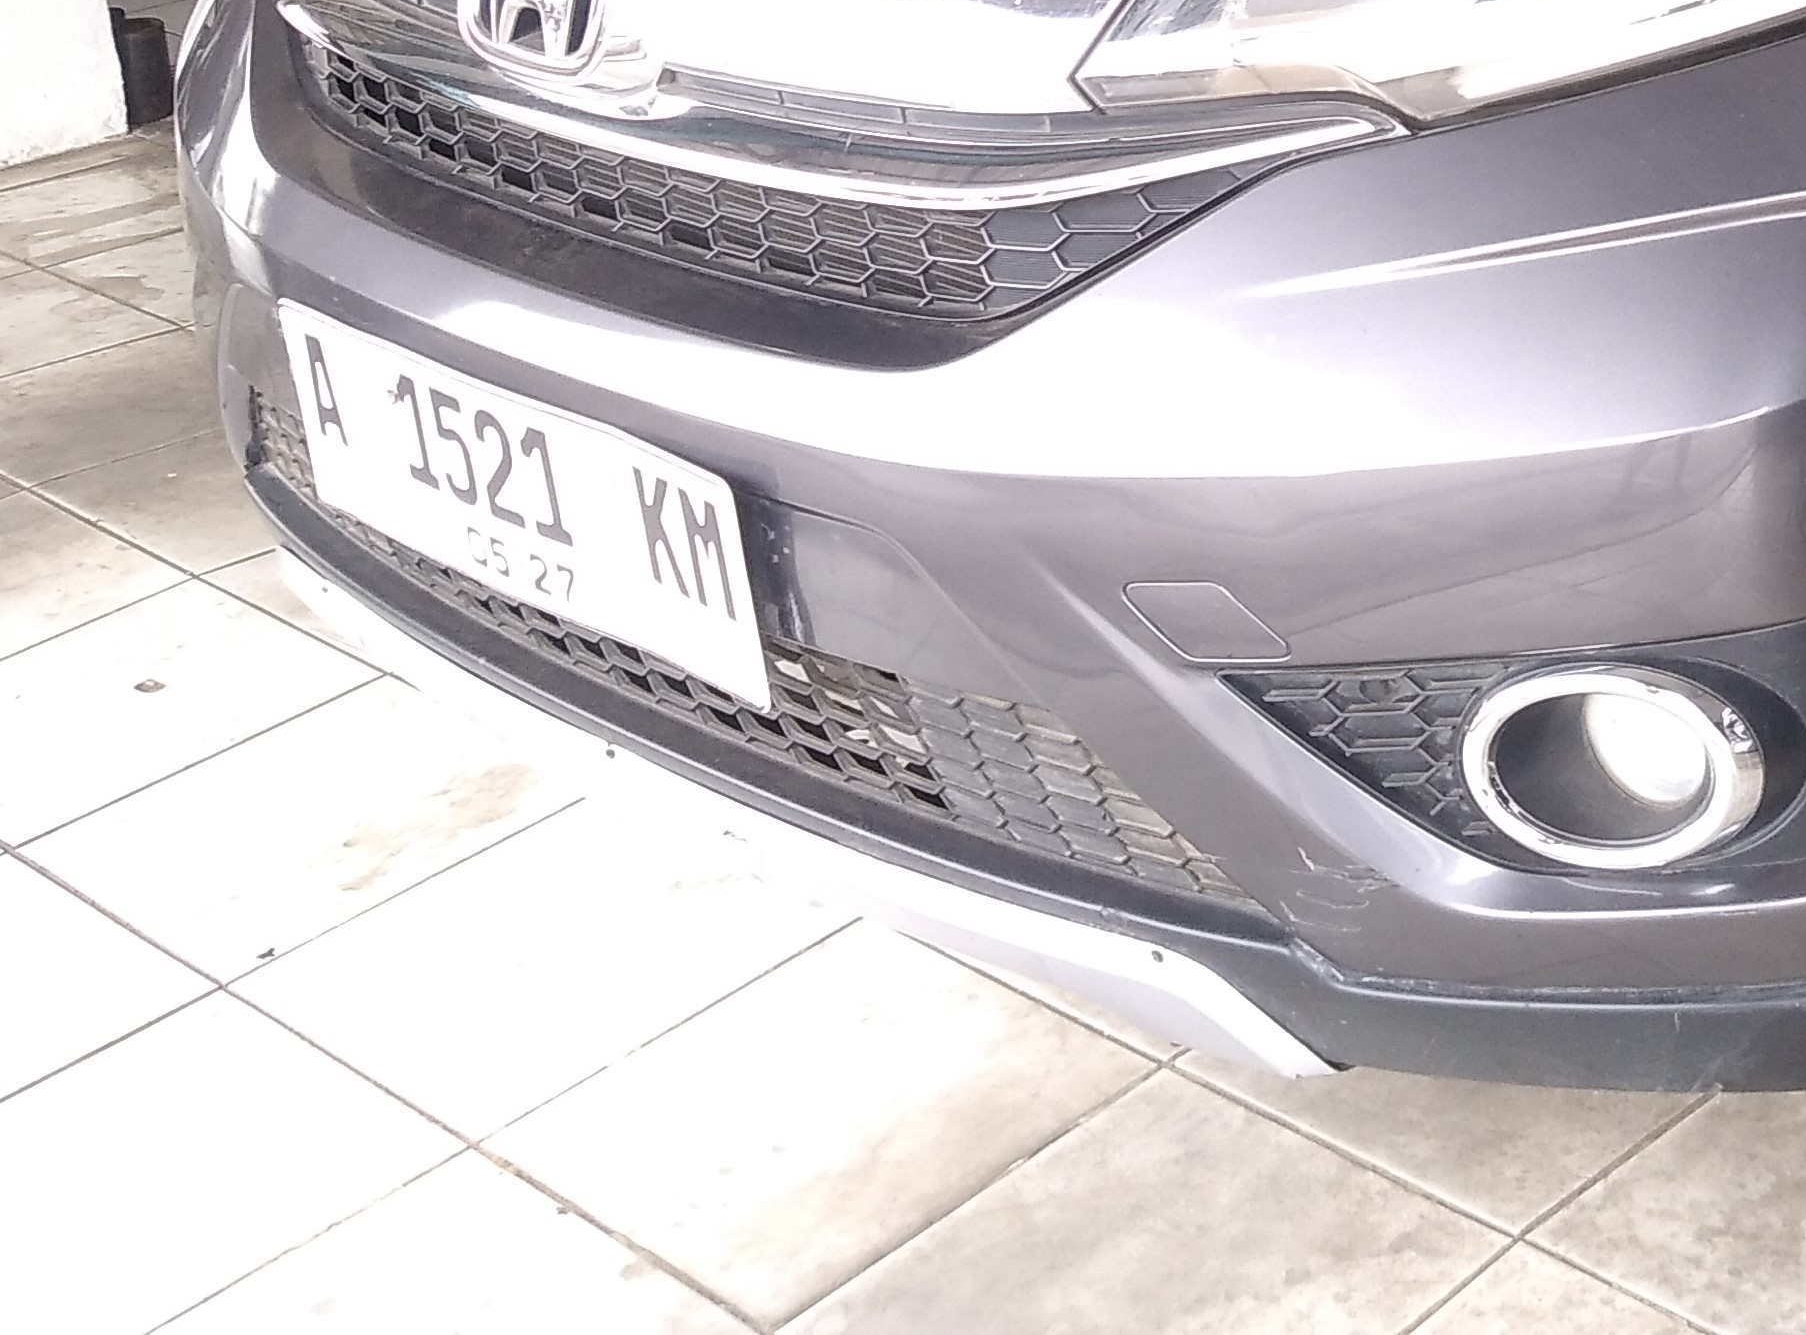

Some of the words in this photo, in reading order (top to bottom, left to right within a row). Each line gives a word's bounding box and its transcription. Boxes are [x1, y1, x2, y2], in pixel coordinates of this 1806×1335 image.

[304, 333, 349, 447] A
[395, 373, 574, 546] 1521
[632, 465, 738, 622] KM
